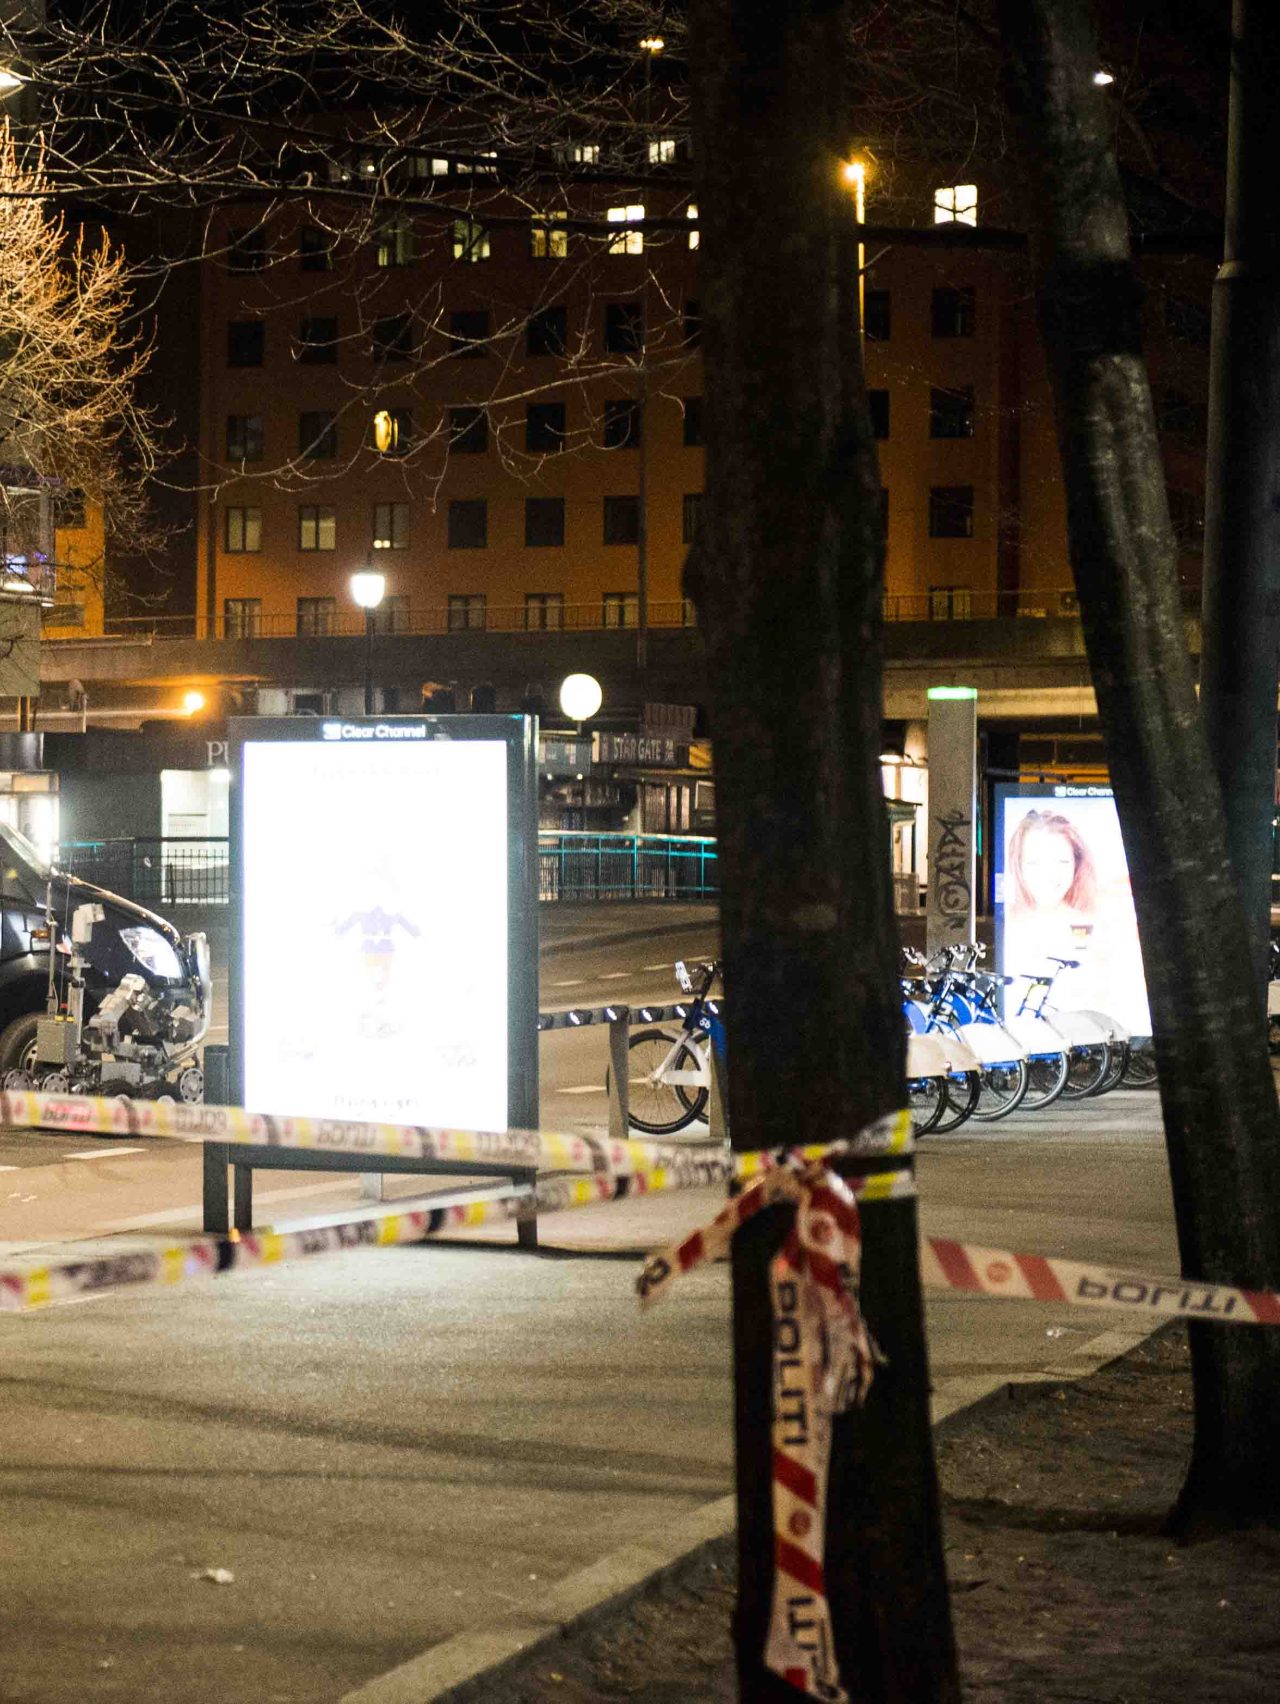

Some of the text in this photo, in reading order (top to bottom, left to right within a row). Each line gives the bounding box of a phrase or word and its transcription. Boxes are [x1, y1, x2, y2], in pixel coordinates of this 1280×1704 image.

[342, 723, 426, 738] Clear Channel
[776, 1281, 808, 1446] POLITI
